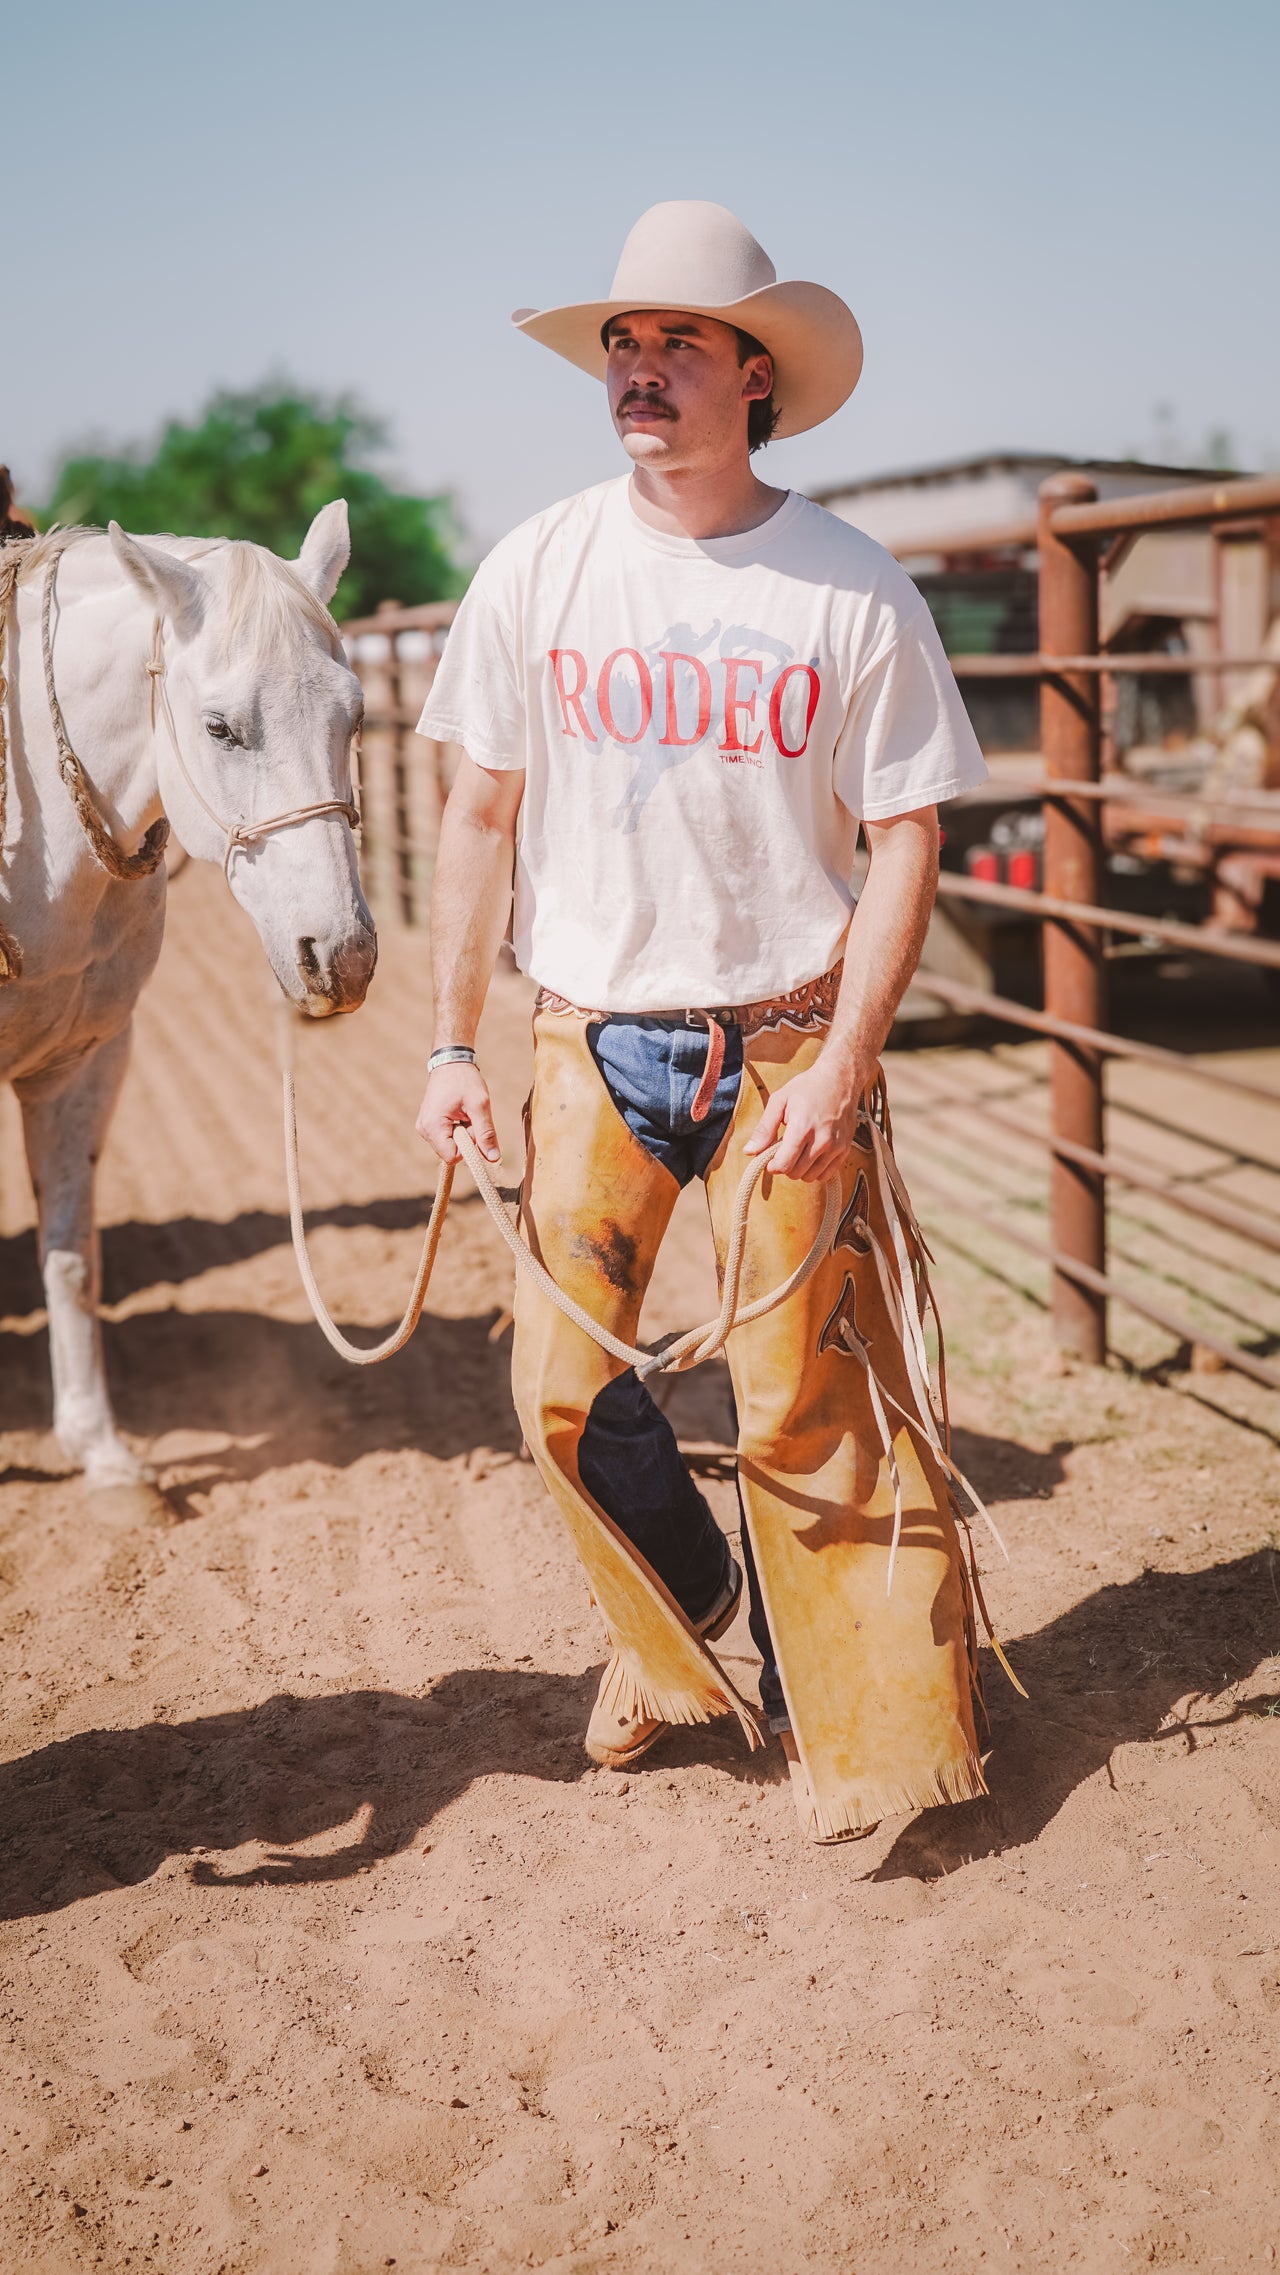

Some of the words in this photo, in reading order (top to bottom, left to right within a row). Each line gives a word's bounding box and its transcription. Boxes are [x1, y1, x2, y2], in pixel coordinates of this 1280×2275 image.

[548, 647, 821, 758] RODEO
[719, 755, 745, 764] TIME
[747, 757, 765, 768] INC.
